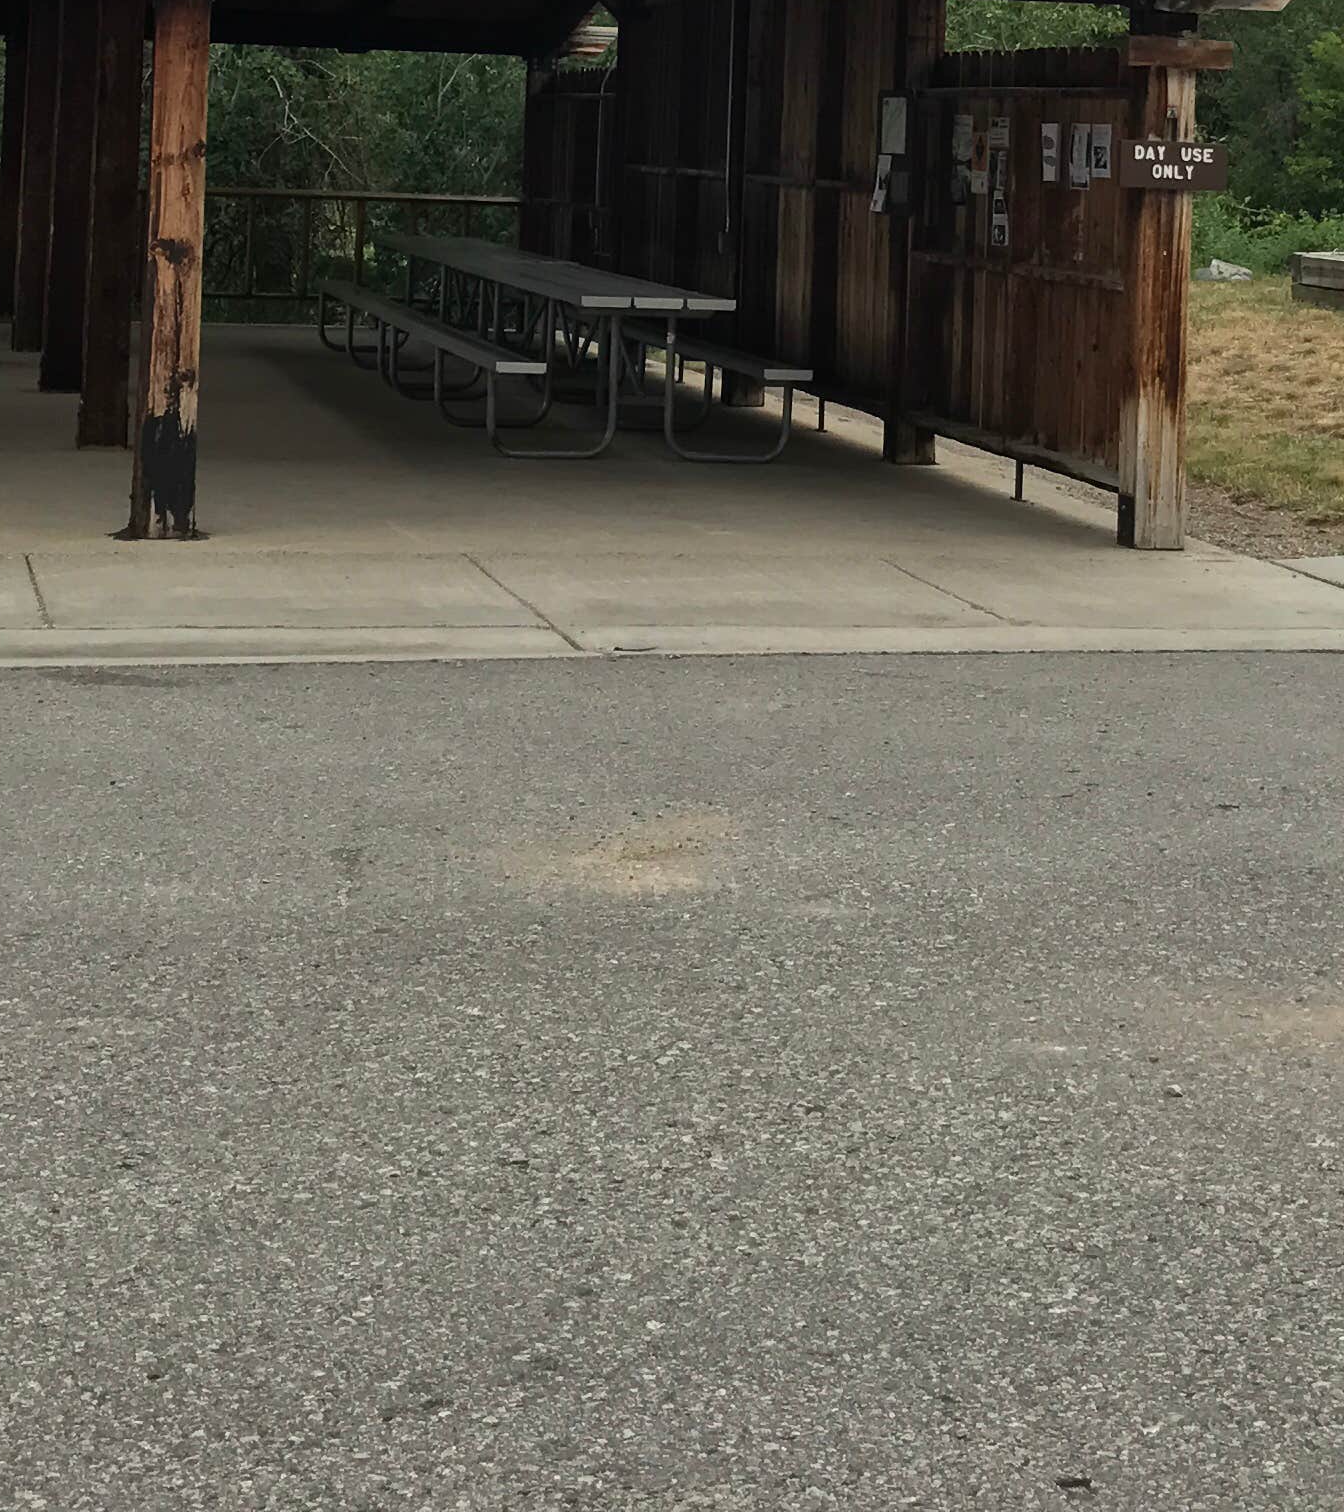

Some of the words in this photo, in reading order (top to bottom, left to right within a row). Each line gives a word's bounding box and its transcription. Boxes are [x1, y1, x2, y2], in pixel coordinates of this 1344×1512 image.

[1134, 144, 1166, 161] DAY
[1180, 147, 1214, 163] USE
[1152, 164, 1194, 180] ONLY
